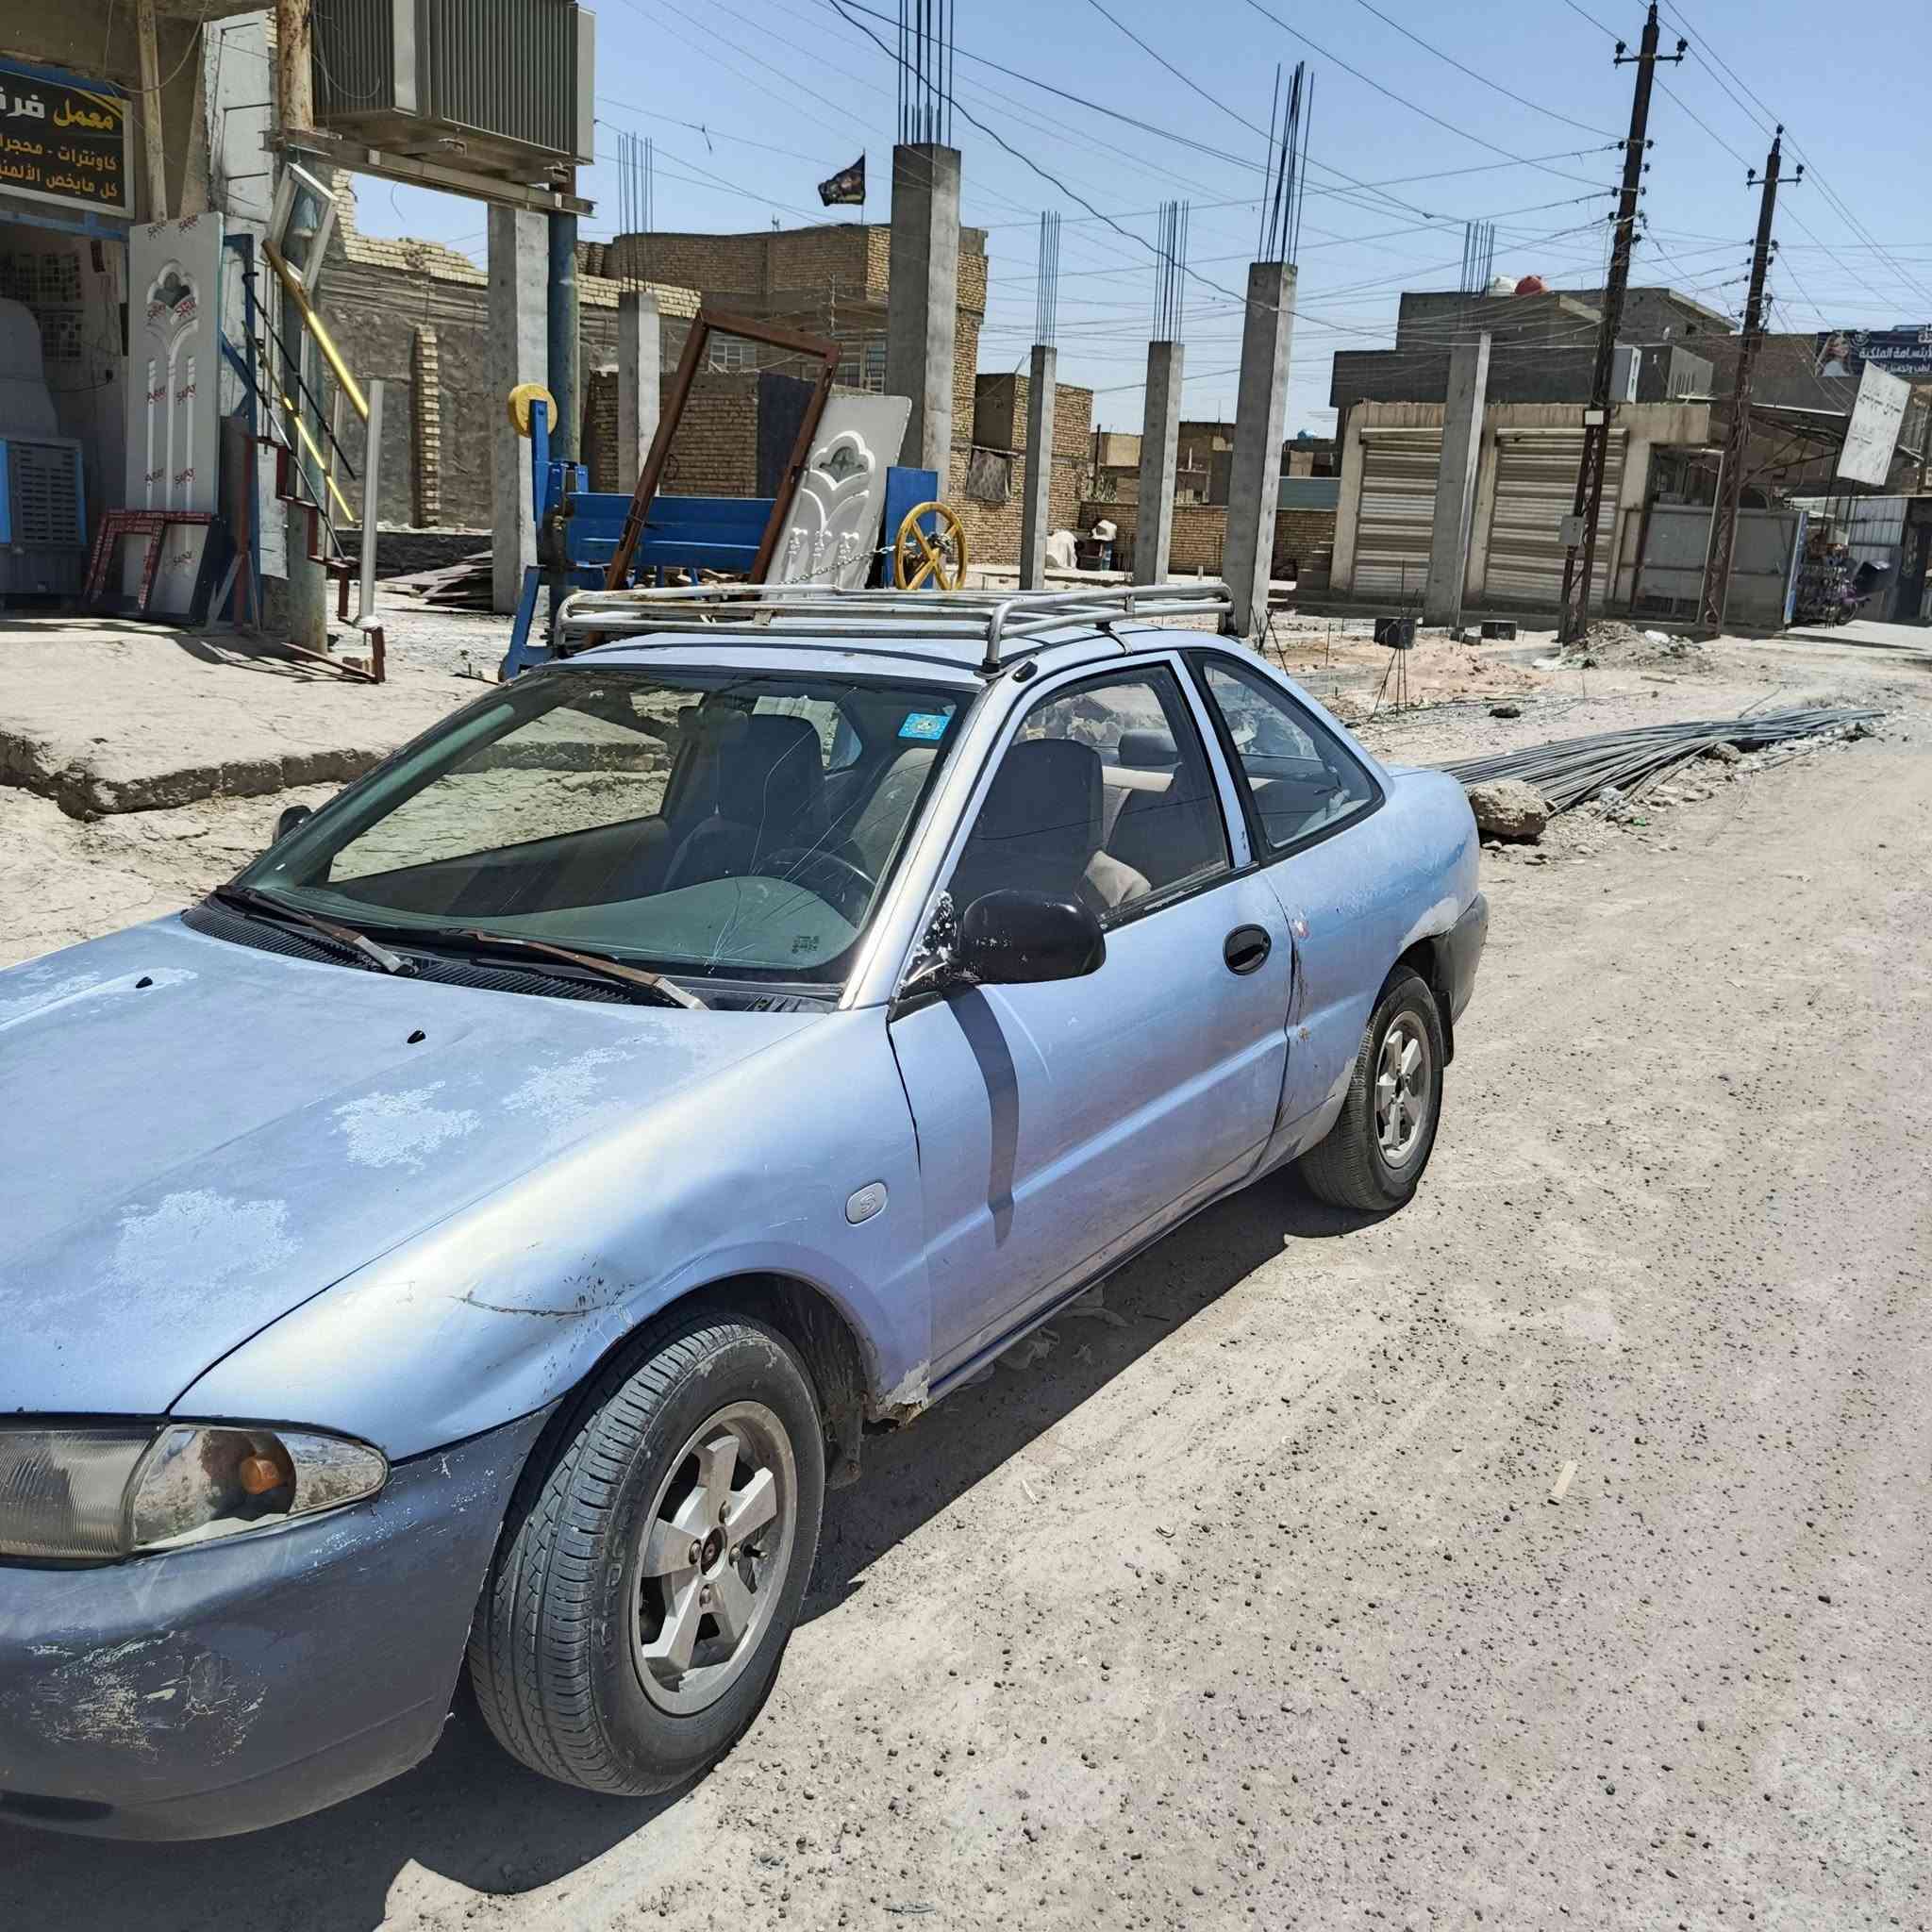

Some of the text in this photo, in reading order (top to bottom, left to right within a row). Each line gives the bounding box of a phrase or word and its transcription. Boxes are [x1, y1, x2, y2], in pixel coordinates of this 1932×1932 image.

[53, 98, 114, 130] معمل
[0, 133, 43, 156] محجرا
[58, 144, 117, 171] كاونترات
[100, 182, 117, 198] كل
